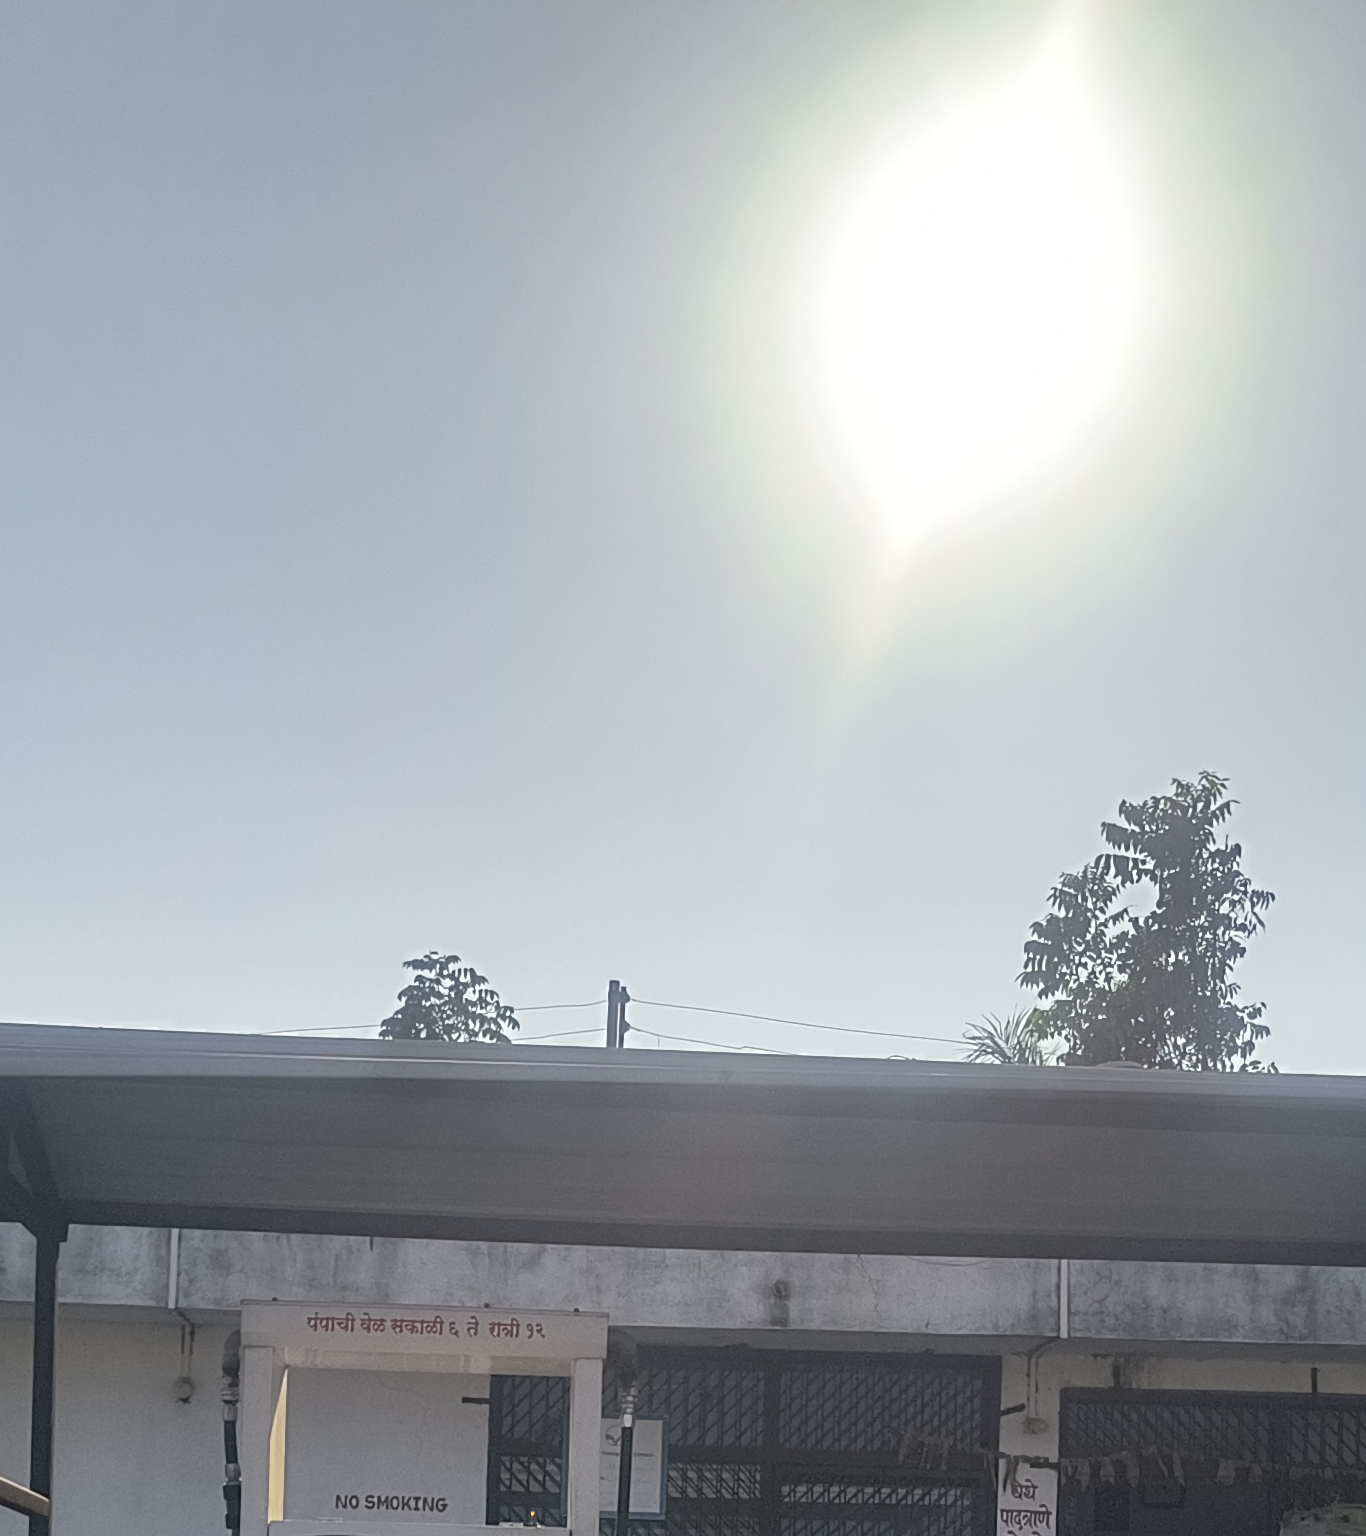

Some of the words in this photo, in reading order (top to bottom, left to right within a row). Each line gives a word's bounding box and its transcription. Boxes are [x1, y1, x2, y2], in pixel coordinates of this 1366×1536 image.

[307, 1312, 355, 1332] पंपाची
[360, 1312, 386, 1333] वेळ
[390, 1315, 444, 1336] सकाळी
[448, 1319, 460, 1338] ६
[467, 1316, 480, 1337] ते
[489, 1317, 520, 1338] रात्री
[526, 1323, 546, 1339] १२
[335, 1494, 360, 1510] NO
[364, 1494, 449, 1513] SMOKING
